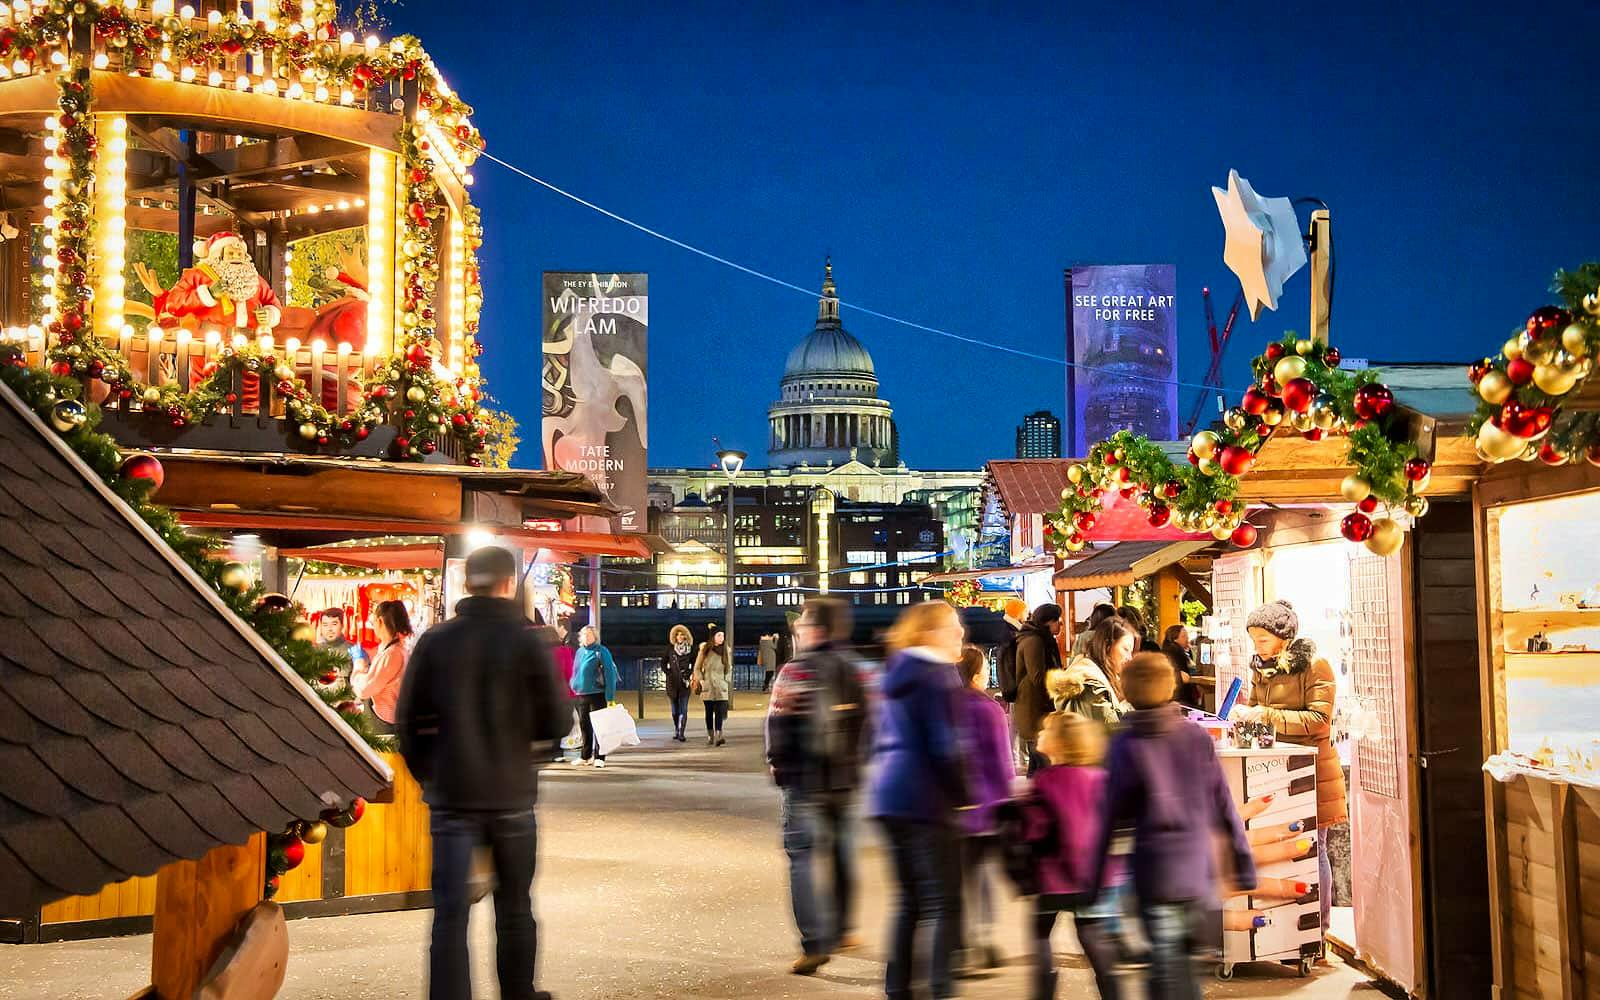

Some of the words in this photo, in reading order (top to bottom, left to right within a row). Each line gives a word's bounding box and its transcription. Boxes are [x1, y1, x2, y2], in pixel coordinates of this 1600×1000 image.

[550, 296, 640, 314] WIFREDO
[1075, 295, 1097, 307] SEE
[1101, 295, 1144, 307] GREAT
[1148, 295, 1174, 307] ART
[1095, 309, 1120, 321] FOR
[1125, 309, 1155, 321] FREE
[573, 318, 617, 335] LAM
[580, 446, 610, 457] TATE
[566, 459, 624, 471] MODERN
[621, 516, 634, 525] EY
[1247, 758, 1285, 774] MOYOU
